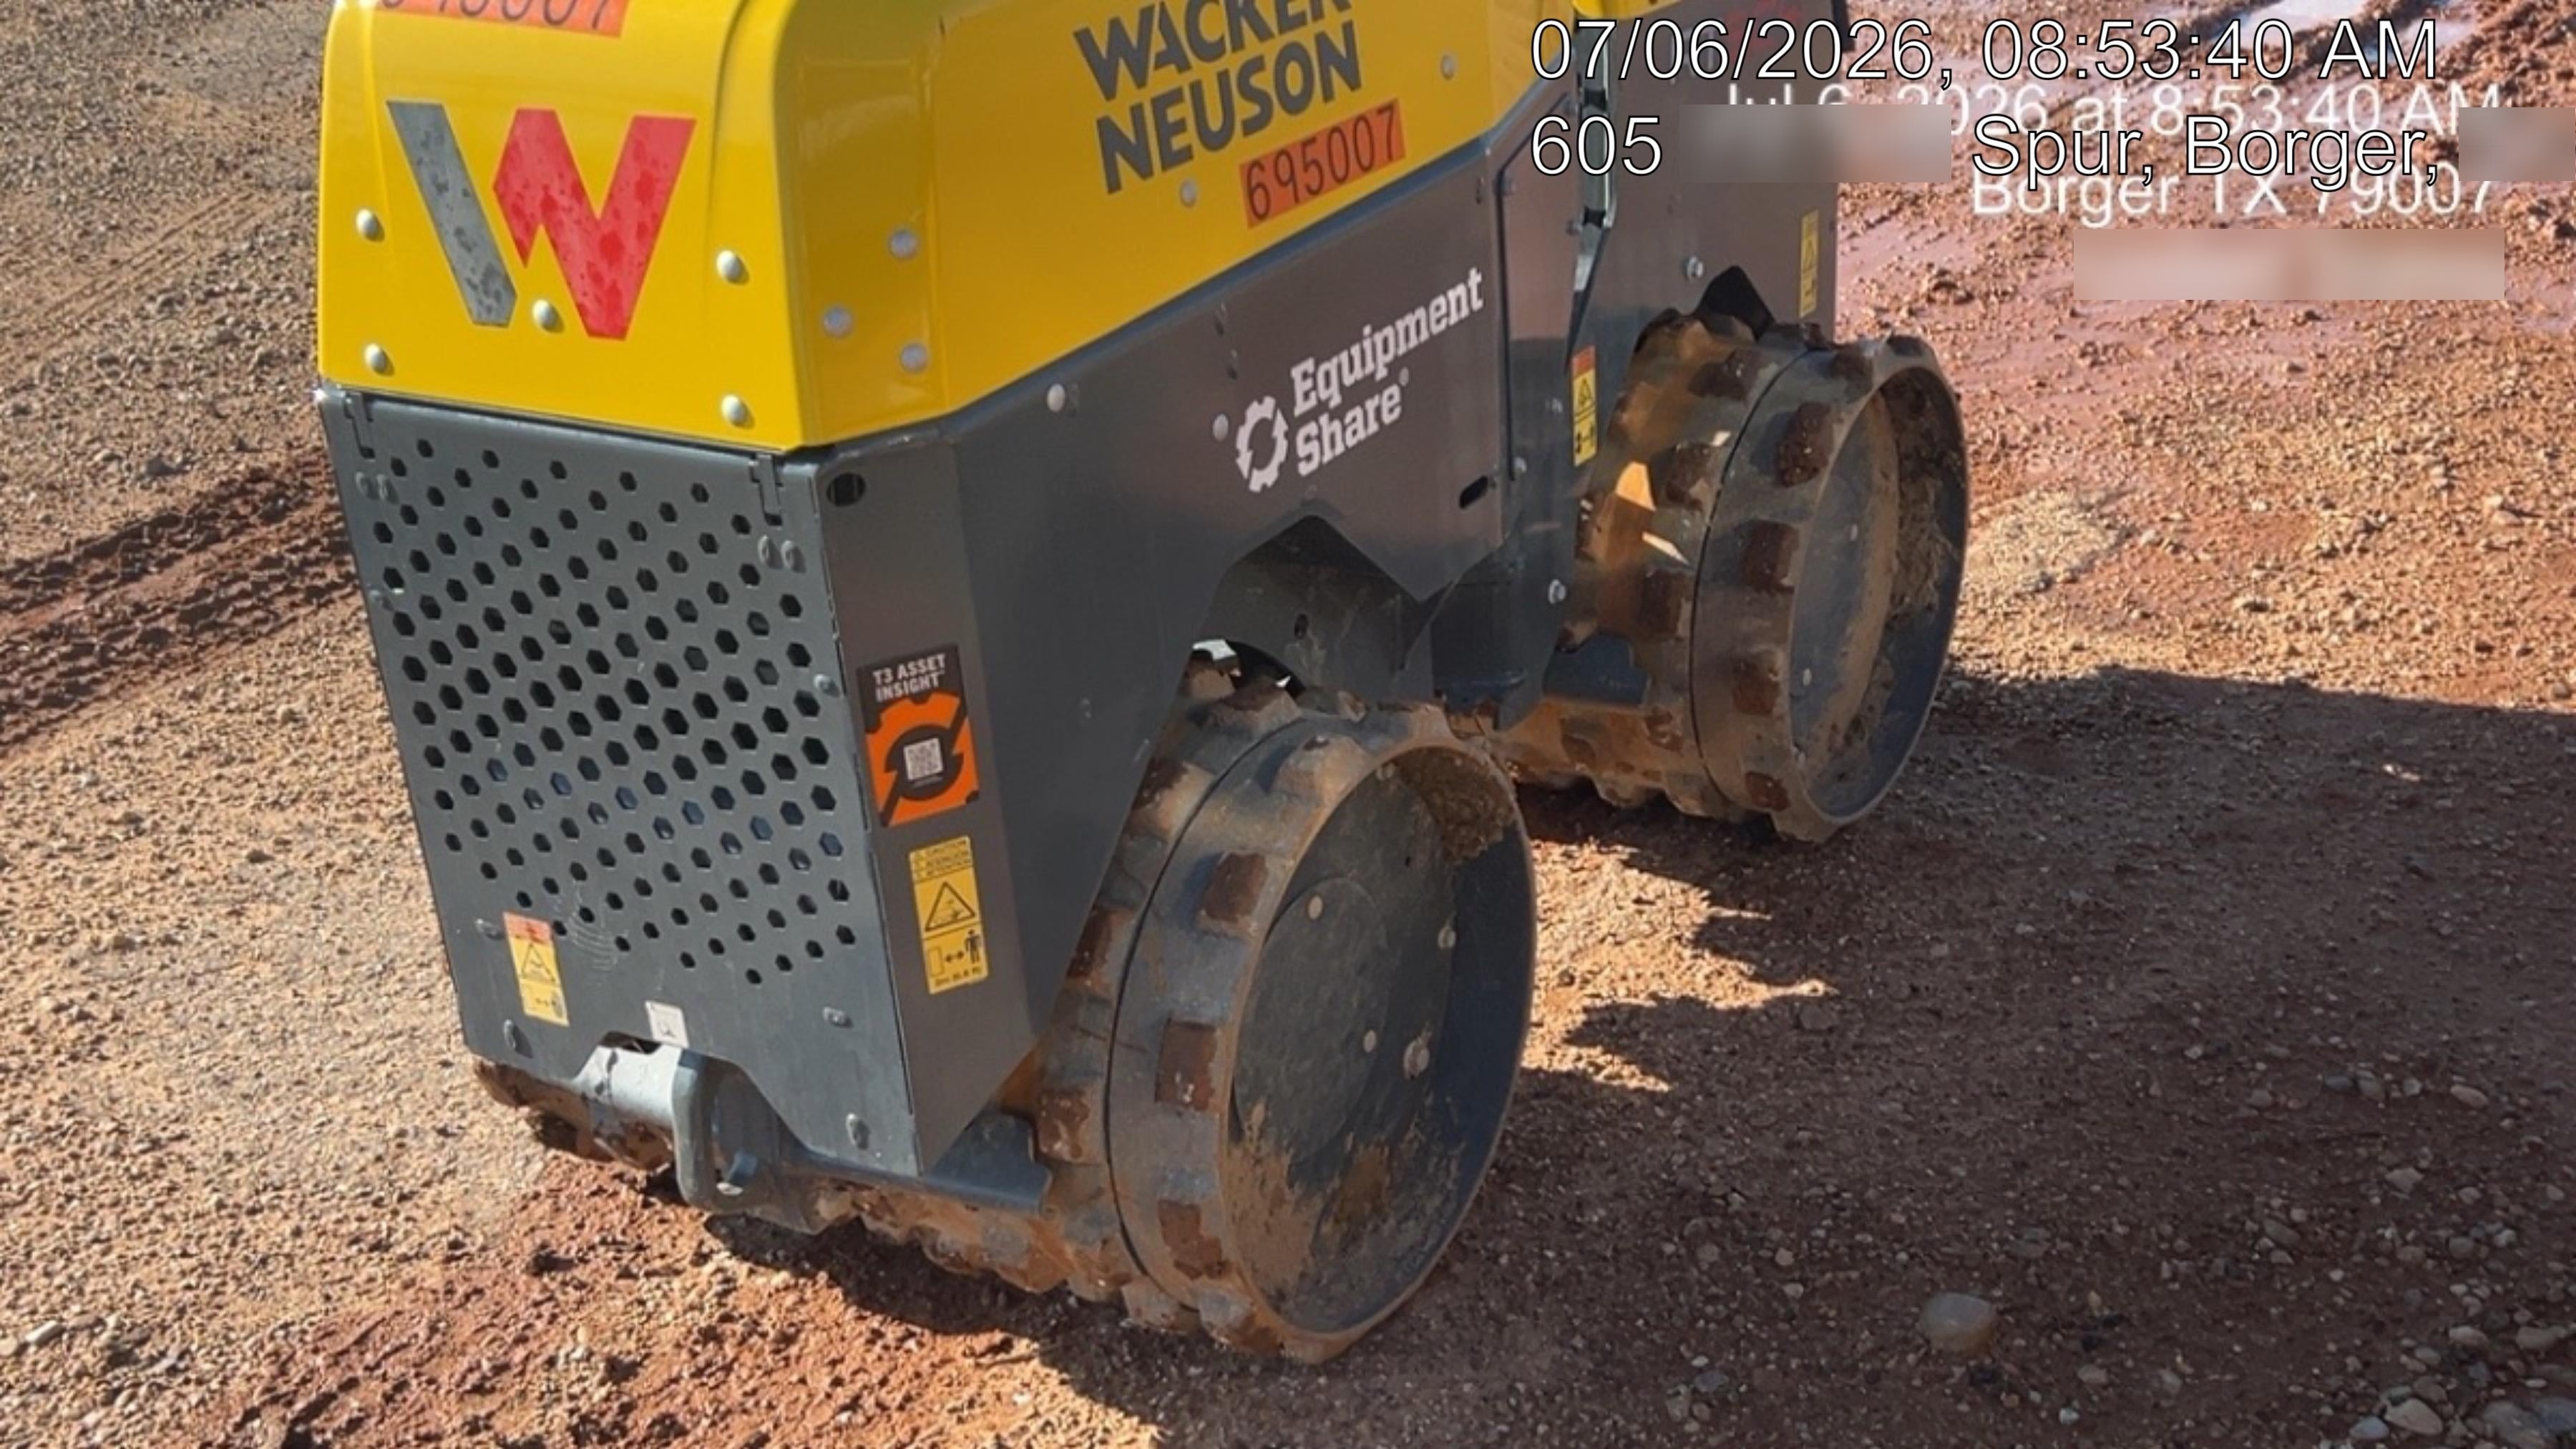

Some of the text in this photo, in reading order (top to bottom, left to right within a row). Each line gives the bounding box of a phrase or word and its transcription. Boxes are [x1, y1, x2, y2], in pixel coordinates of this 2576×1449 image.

[1096, 19, 1361, 195] NEUSON
[1246, 103, 1395, 220] 695007
[1291, 267, 1483, 416] Equipment
[872, 653, 946, 686] T3 ASSET
[875, 671, 940, 702] INSIGHT
